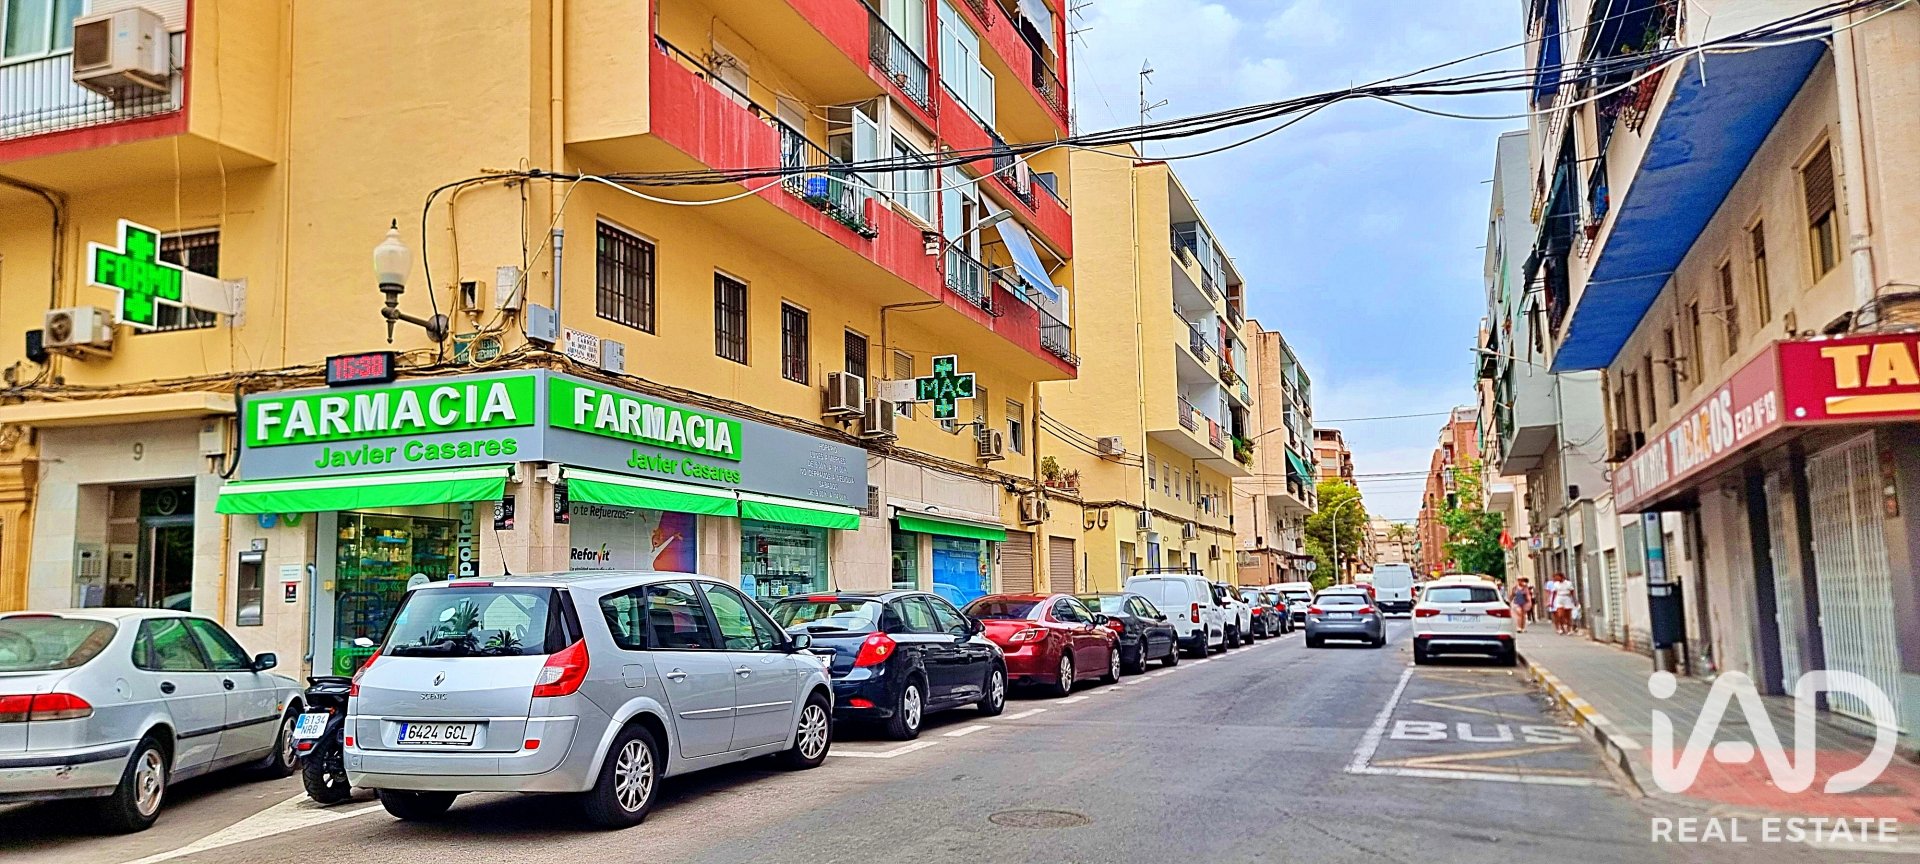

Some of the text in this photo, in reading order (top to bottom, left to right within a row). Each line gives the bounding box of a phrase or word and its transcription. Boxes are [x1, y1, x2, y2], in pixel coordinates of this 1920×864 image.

[1820, 341, 1920, 389] TA
[920, 376, 972, 399] MAC
[257, 382, 517, 441] FARMACIA
[574, 387, 733, 454] FARMACIA
[133, 442, 144, 461] 9
[315, 437, 518, 469] Javier Casares
[627, 449, 741, 484] Javier Casares
[573, 506, 579, 515] o
[580, 505, 588, 516] te
[420, 692, 448, 701] SCENIC
[300, 724, 318, 735] NRB
[304, 714, 326, 725] 6134
[408, 724, 468, 740] 6424 GCL
[1390, 719, 1582, 744] BUS
